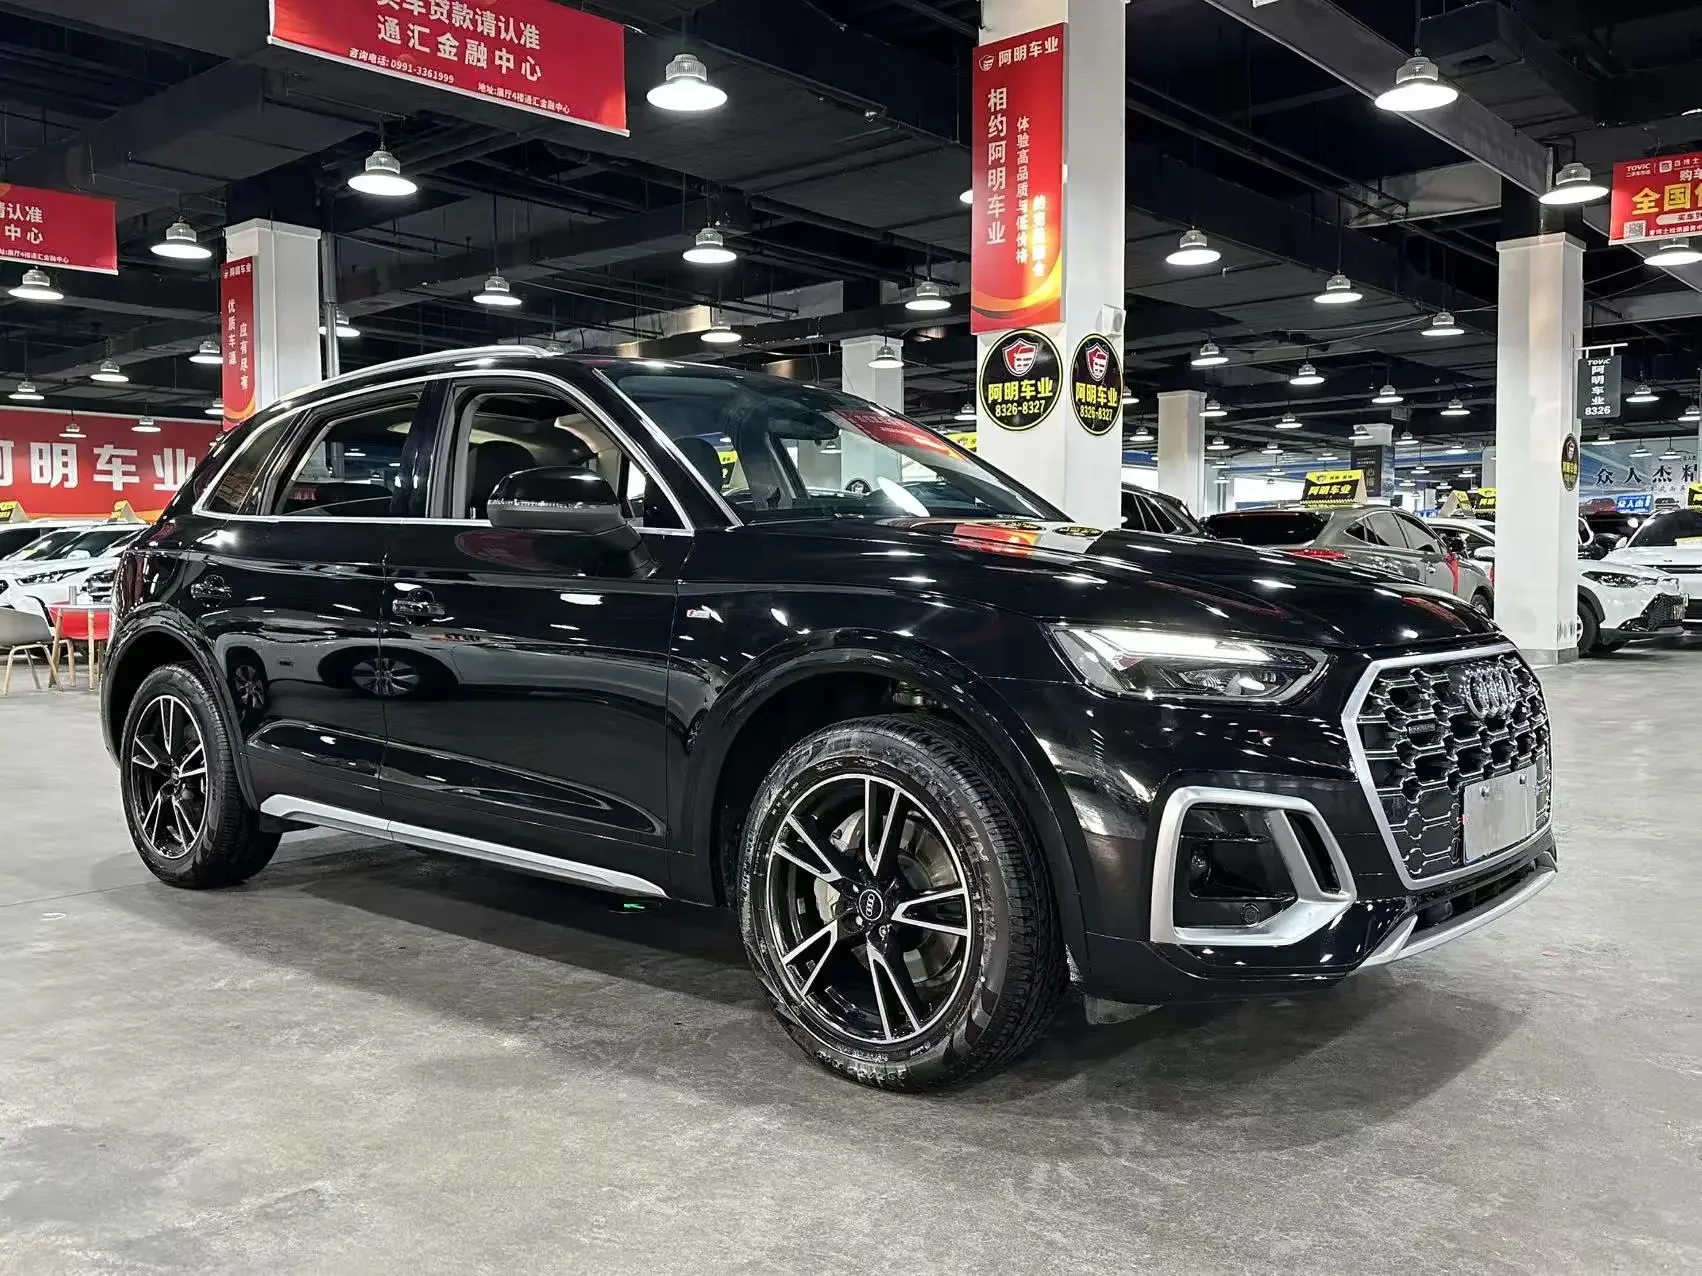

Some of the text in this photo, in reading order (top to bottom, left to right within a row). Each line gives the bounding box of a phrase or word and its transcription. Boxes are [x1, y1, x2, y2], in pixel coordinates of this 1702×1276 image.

[377, 15, 542, 82] 通汇金融中心
[998, 36, 1059, 67] 阿明车业
[987, 87, 1007, 245] 相约阿明车业
[1626, 162, 1652, 172] TOVIC
[5, 223, 44, 244] 中心
[1587, 358, 1611, 366] TOVIC
[987, 376, 1053, 404] 阿明车业
[1075, 381, 1118, 407] 阿明车业
[1591, 365, 1605, 405] 阿明车业
[995, 400, 1046, 418] 8326-8327
[1584, 405, 1611, 416] 8326
[0, 440, 197, 492] 明车业
